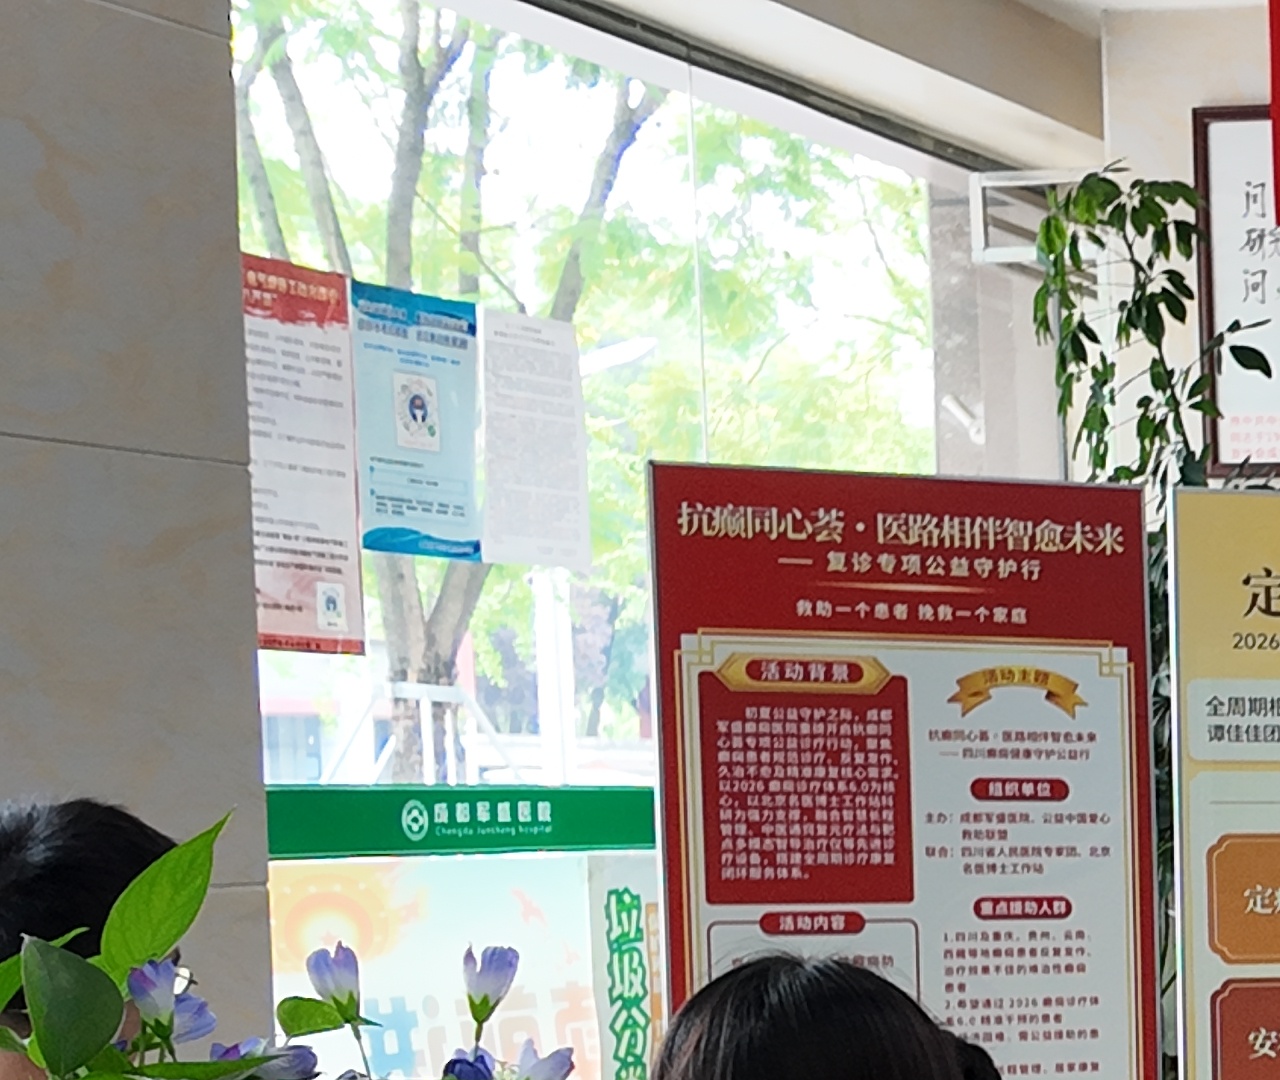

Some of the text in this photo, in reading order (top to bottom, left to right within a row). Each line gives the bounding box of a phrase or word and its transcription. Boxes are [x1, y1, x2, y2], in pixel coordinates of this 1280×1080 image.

[677, 502, 1125, 555] 抗癫同心荟·医路相伴智愈未来
[761, 664, 849, 682] 活动背景
[989, 782, 1051, 797] 组织单位
[780, 914, 845, 931] 活动内容
